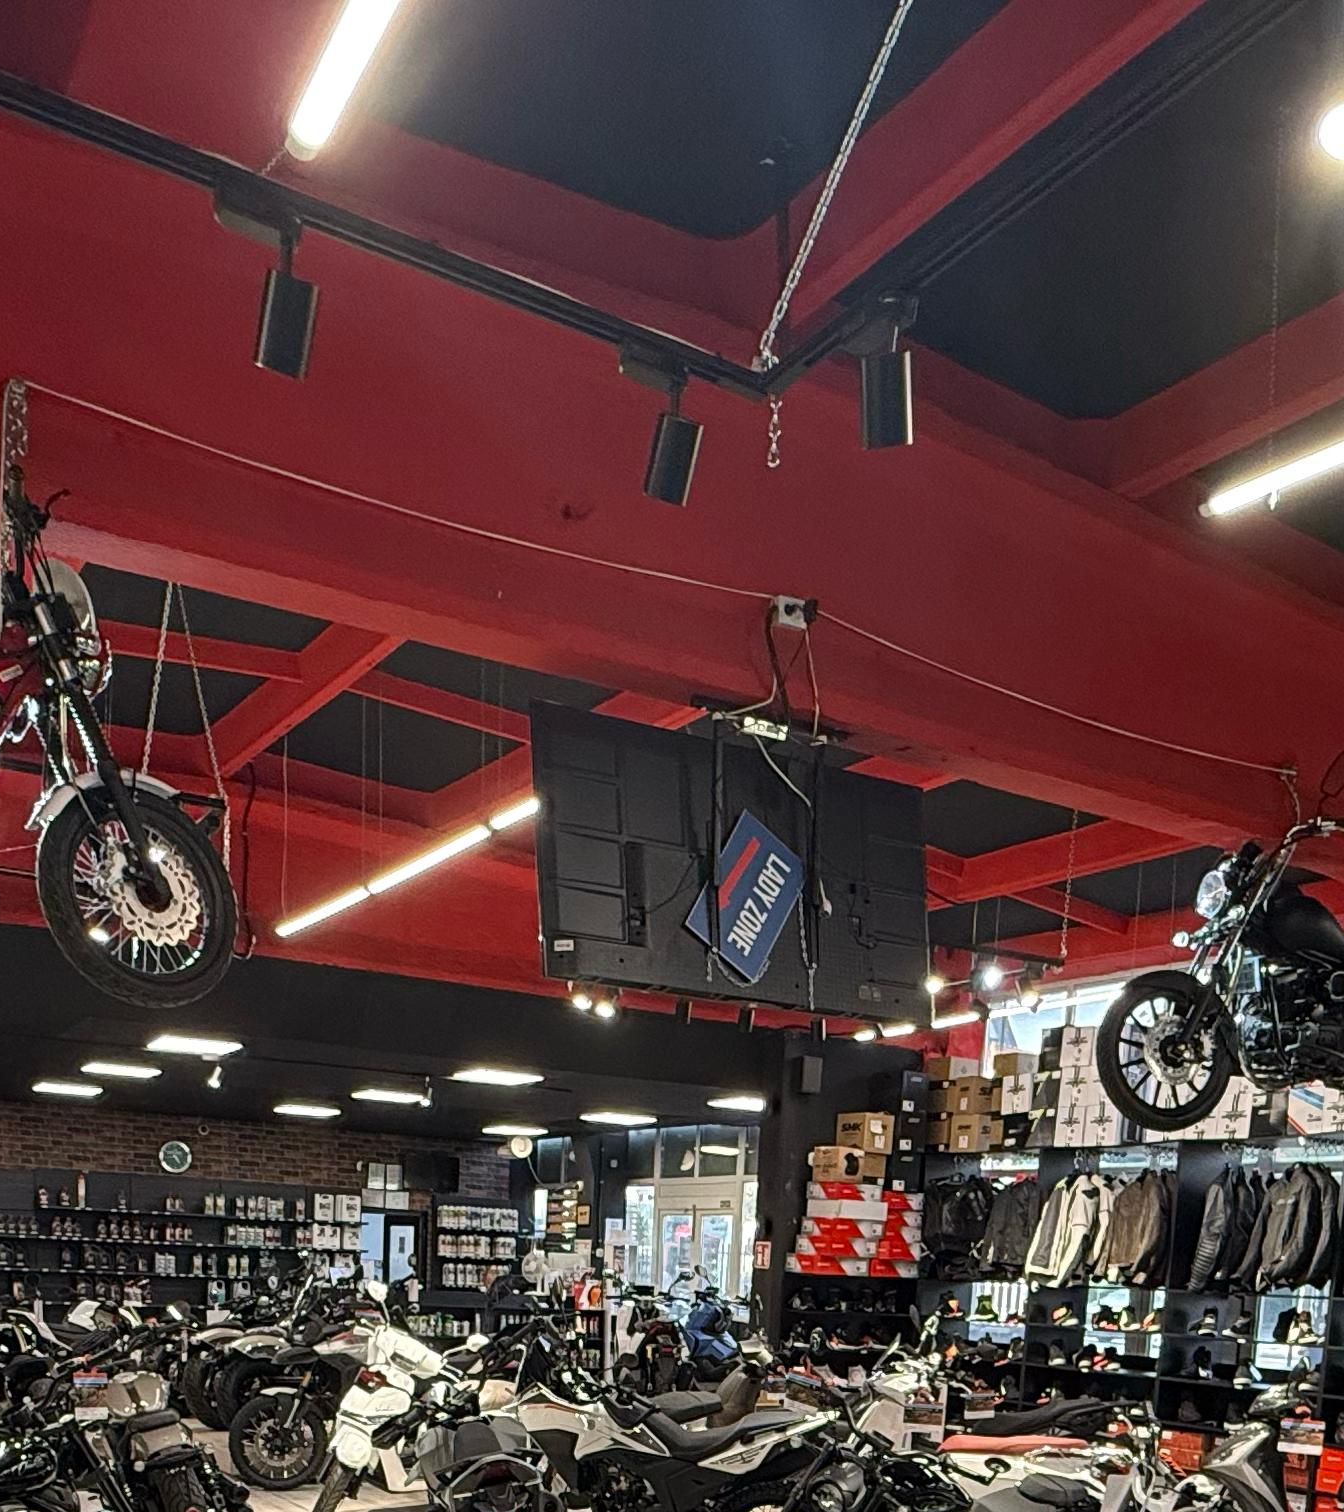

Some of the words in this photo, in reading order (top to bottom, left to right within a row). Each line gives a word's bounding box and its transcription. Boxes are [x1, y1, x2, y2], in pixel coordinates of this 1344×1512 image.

[752, 852, 792, 910] LADY
[726, 897, 769, 957] ZONE
[840, 1122, 864, 1133] SMK
